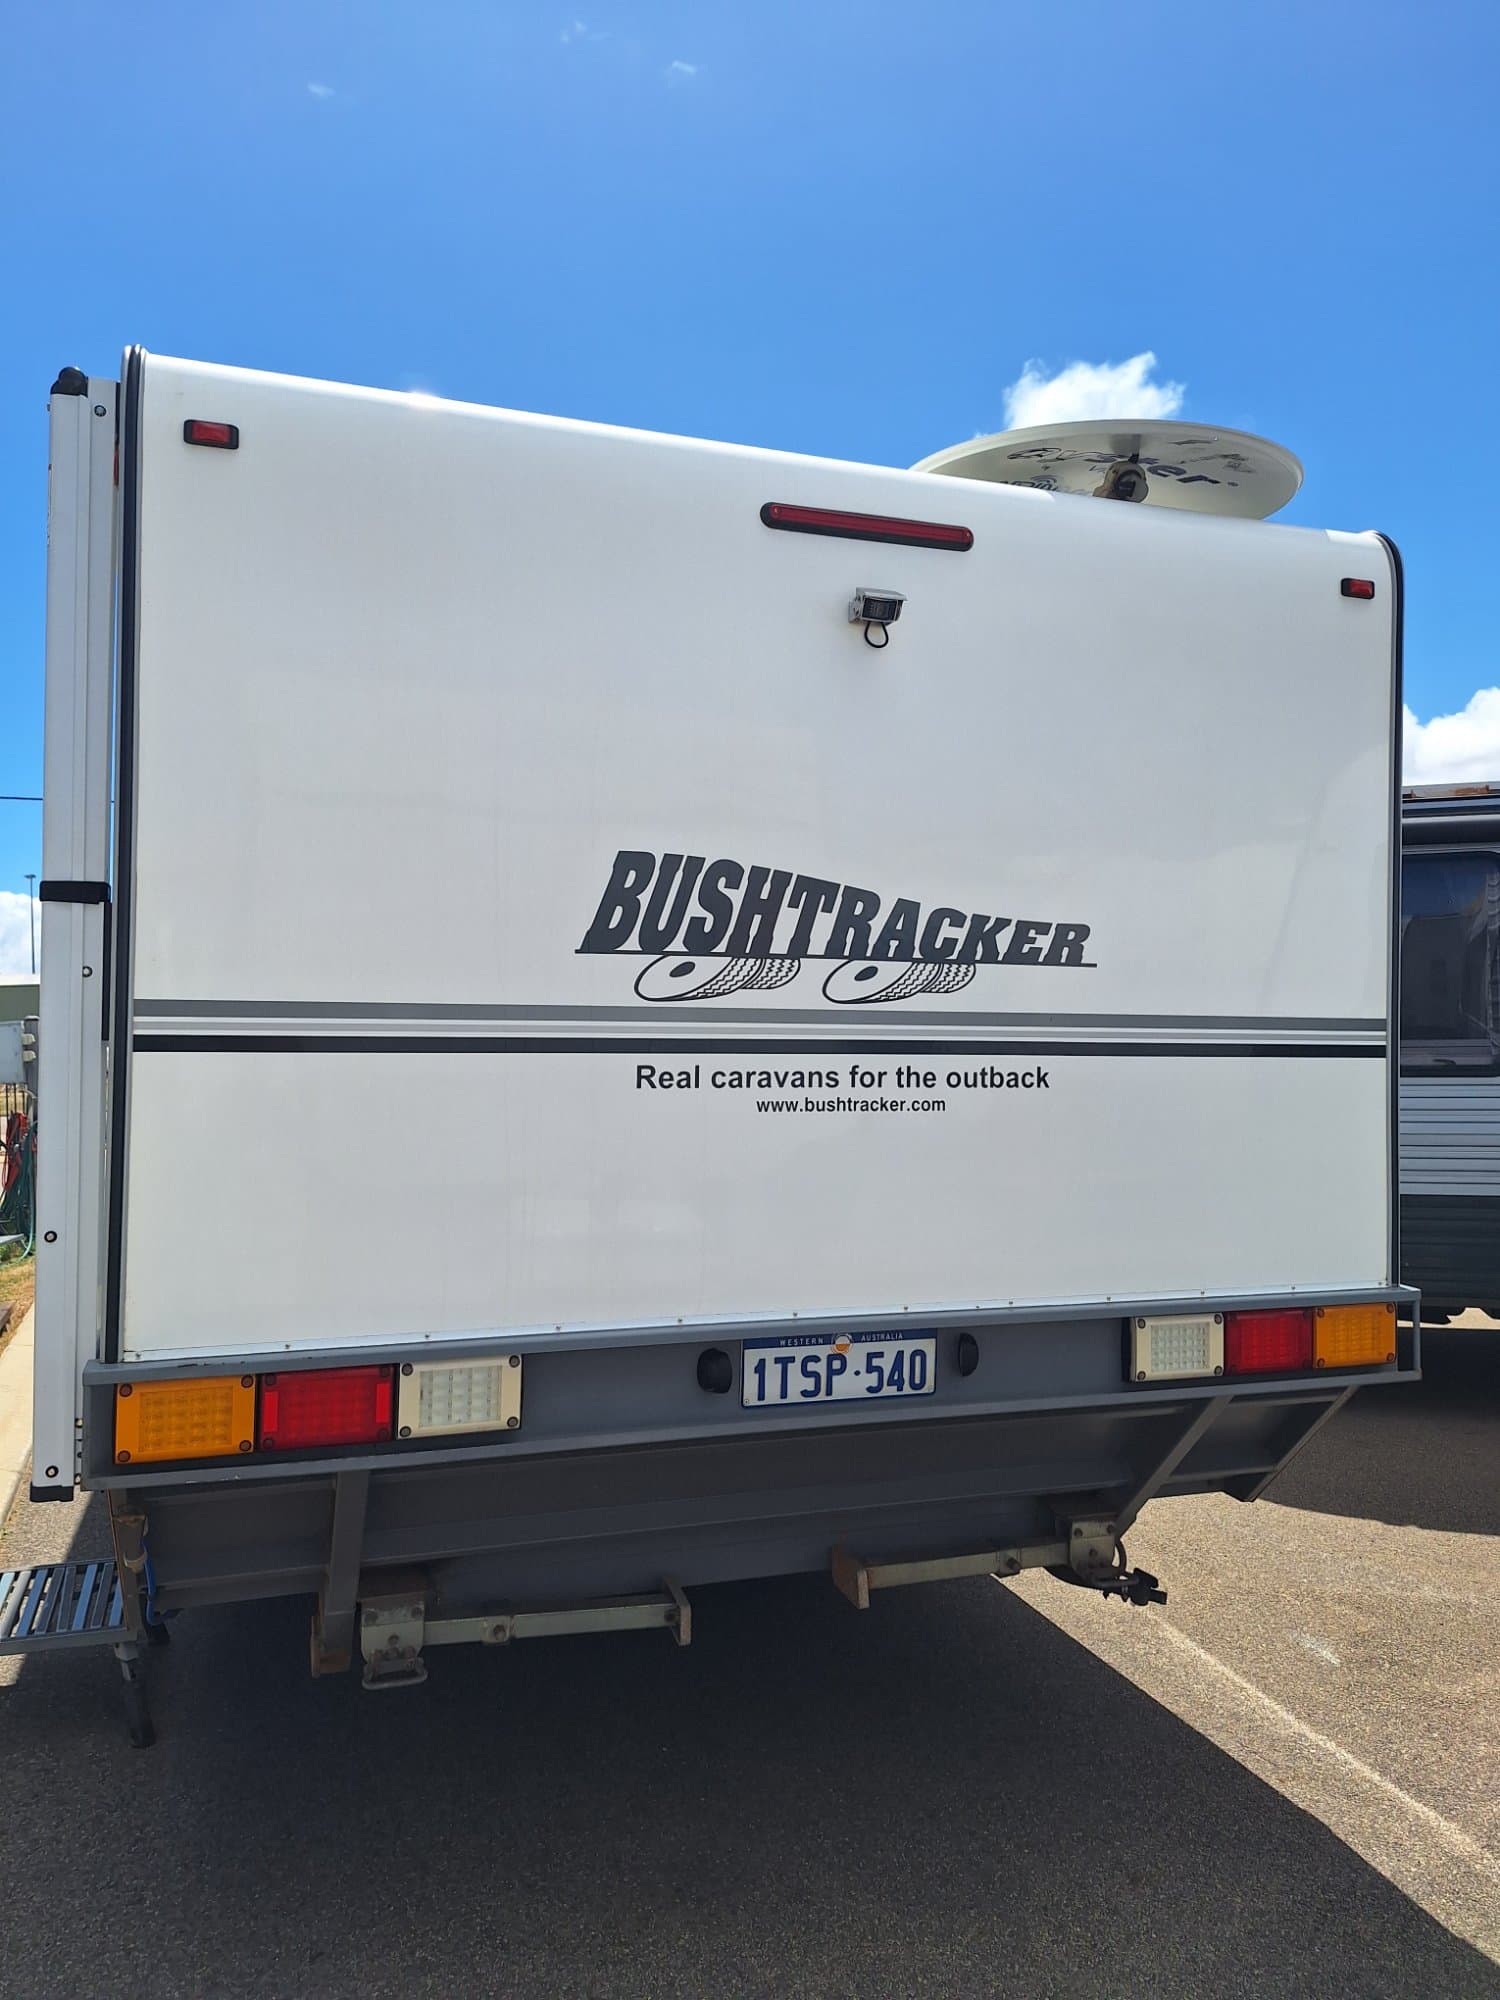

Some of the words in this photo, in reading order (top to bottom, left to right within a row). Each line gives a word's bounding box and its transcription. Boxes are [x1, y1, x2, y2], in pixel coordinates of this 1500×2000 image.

[578, 850, 1095, 965] BUSHTRACKER
[636, 1065, 700, 1090] Real
[711, 1070, 840, 1089] caravans
[849, 1065, 888, 1089] for
[896, 1066, 937, 1089] the
[946, 1067, 1050, 1090] outback
[757, 1097, 946, 1113] www.bushtracker.com
[780, 1337, 824, 1346] WESTERN
[861, 1333, 903, 1342] AUSTRALIA
